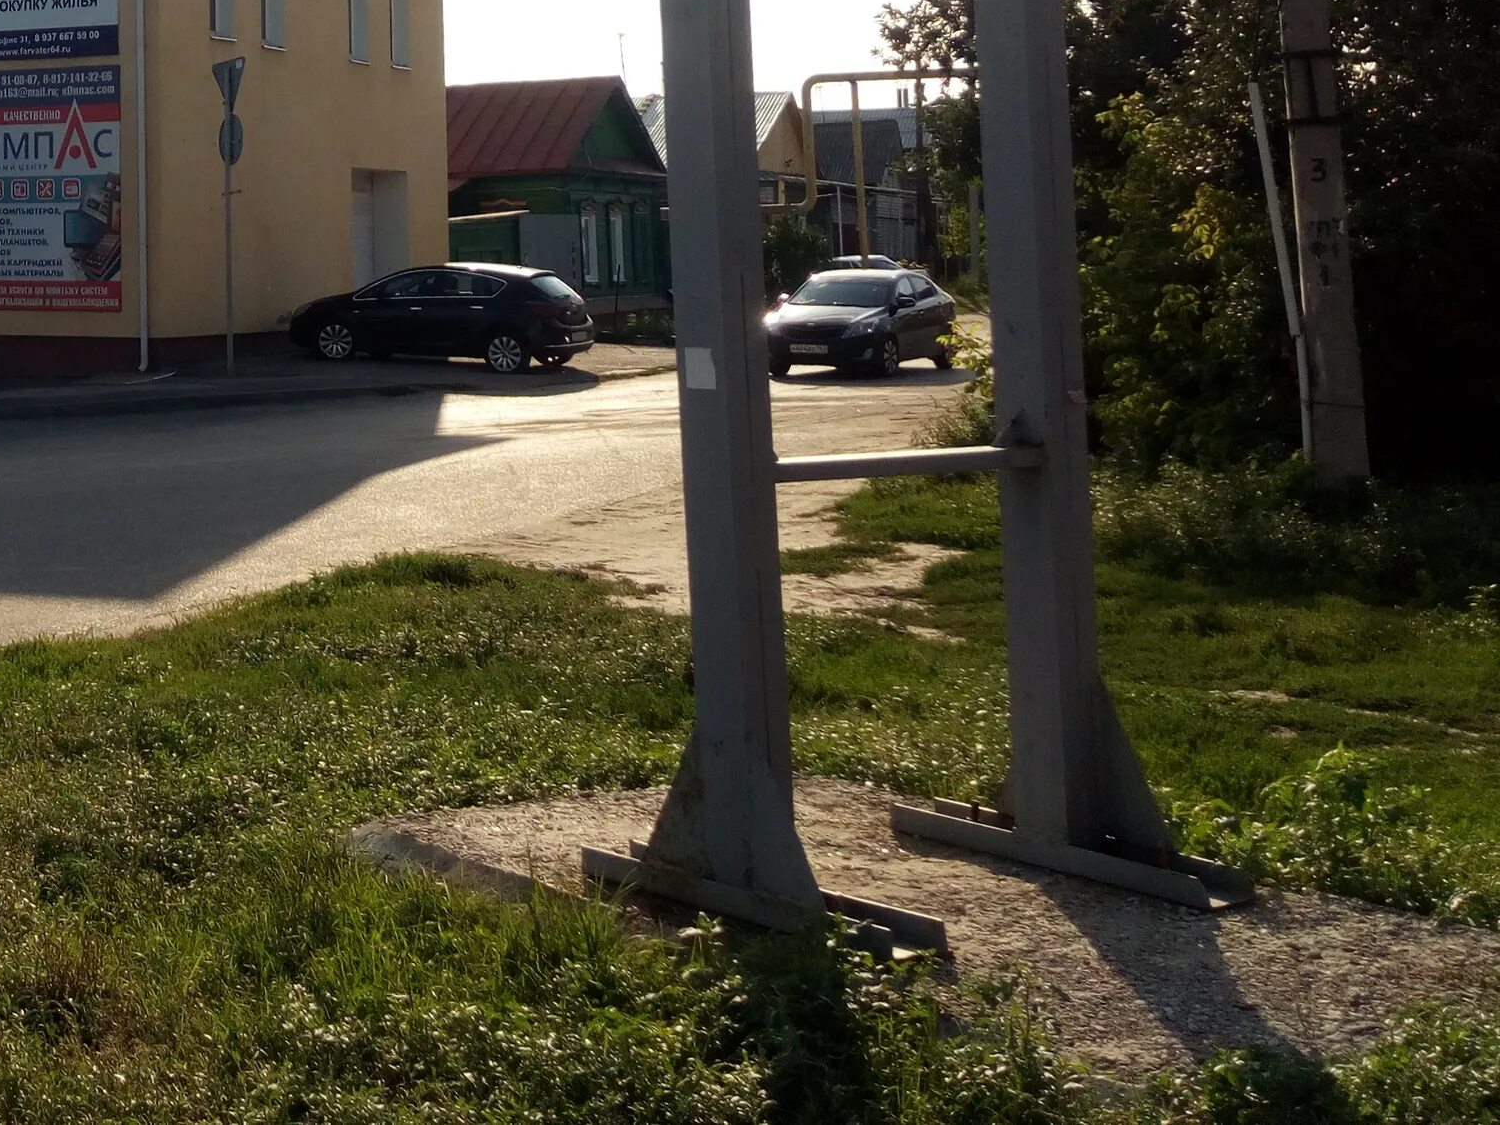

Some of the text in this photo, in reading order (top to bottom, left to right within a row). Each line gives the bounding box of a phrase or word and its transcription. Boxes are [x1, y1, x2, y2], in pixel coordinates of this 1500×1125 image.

[41, 32, 57, 42] 937
[89, 29, 100, 39] 00
[3, 109, 61, 121] КАЧЕСТВЕННО
[1310, 158, 1326, 182] 3
[7, 228, 44, 236] ТЕХНИКИ
